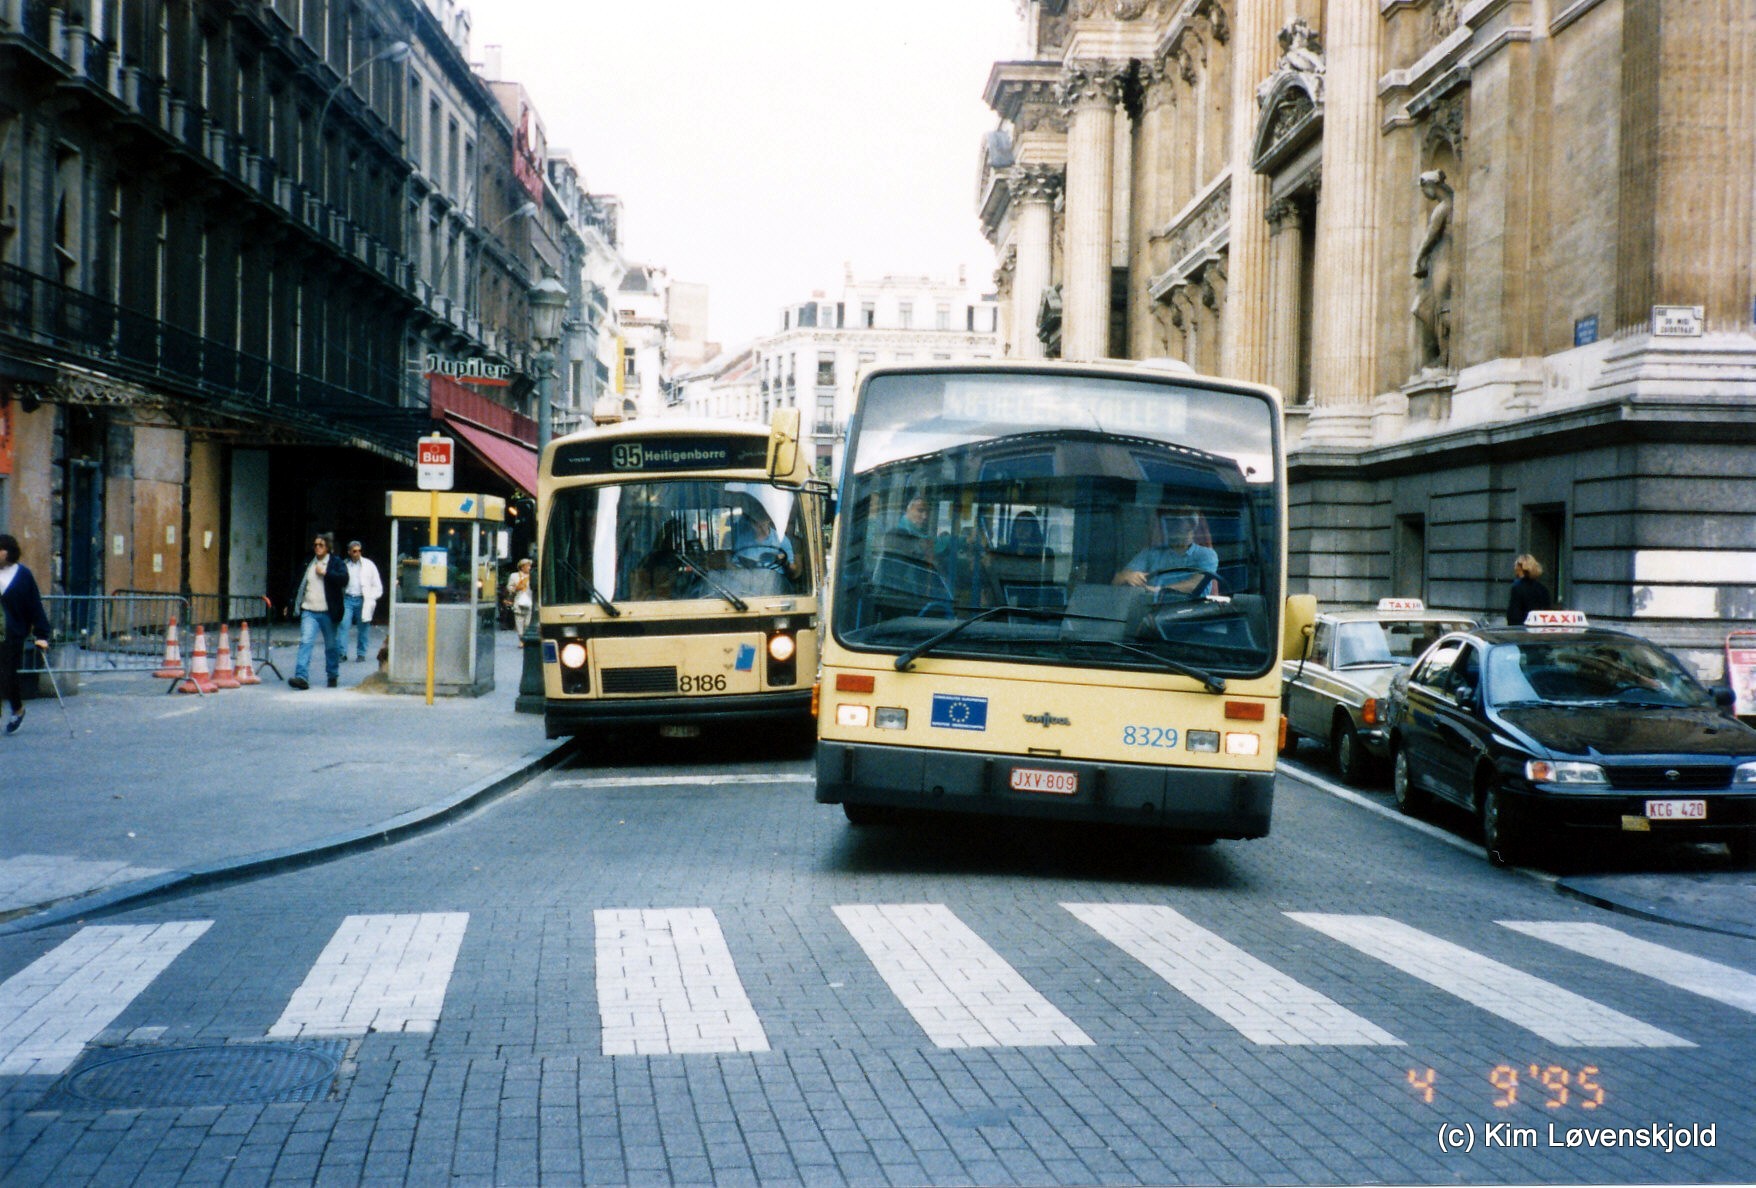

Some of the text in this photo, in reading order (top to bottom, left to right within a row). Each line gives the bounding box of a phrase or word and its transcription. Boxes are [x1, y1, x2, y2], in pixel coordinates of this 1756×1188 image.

[427, 353, 510, 385] Jupiler
[423, 452, 446, 463] Bus
[613, 443, 643, 467] 95
[645, 449, 726, 463] Heiligenborre
[1388, 601, 1416, 609] TAXI
[1539, 614, 1577, 624] TAXI
[680, 674, 727, 692] 8186
[1123, 725, 1178, 748] 8329
